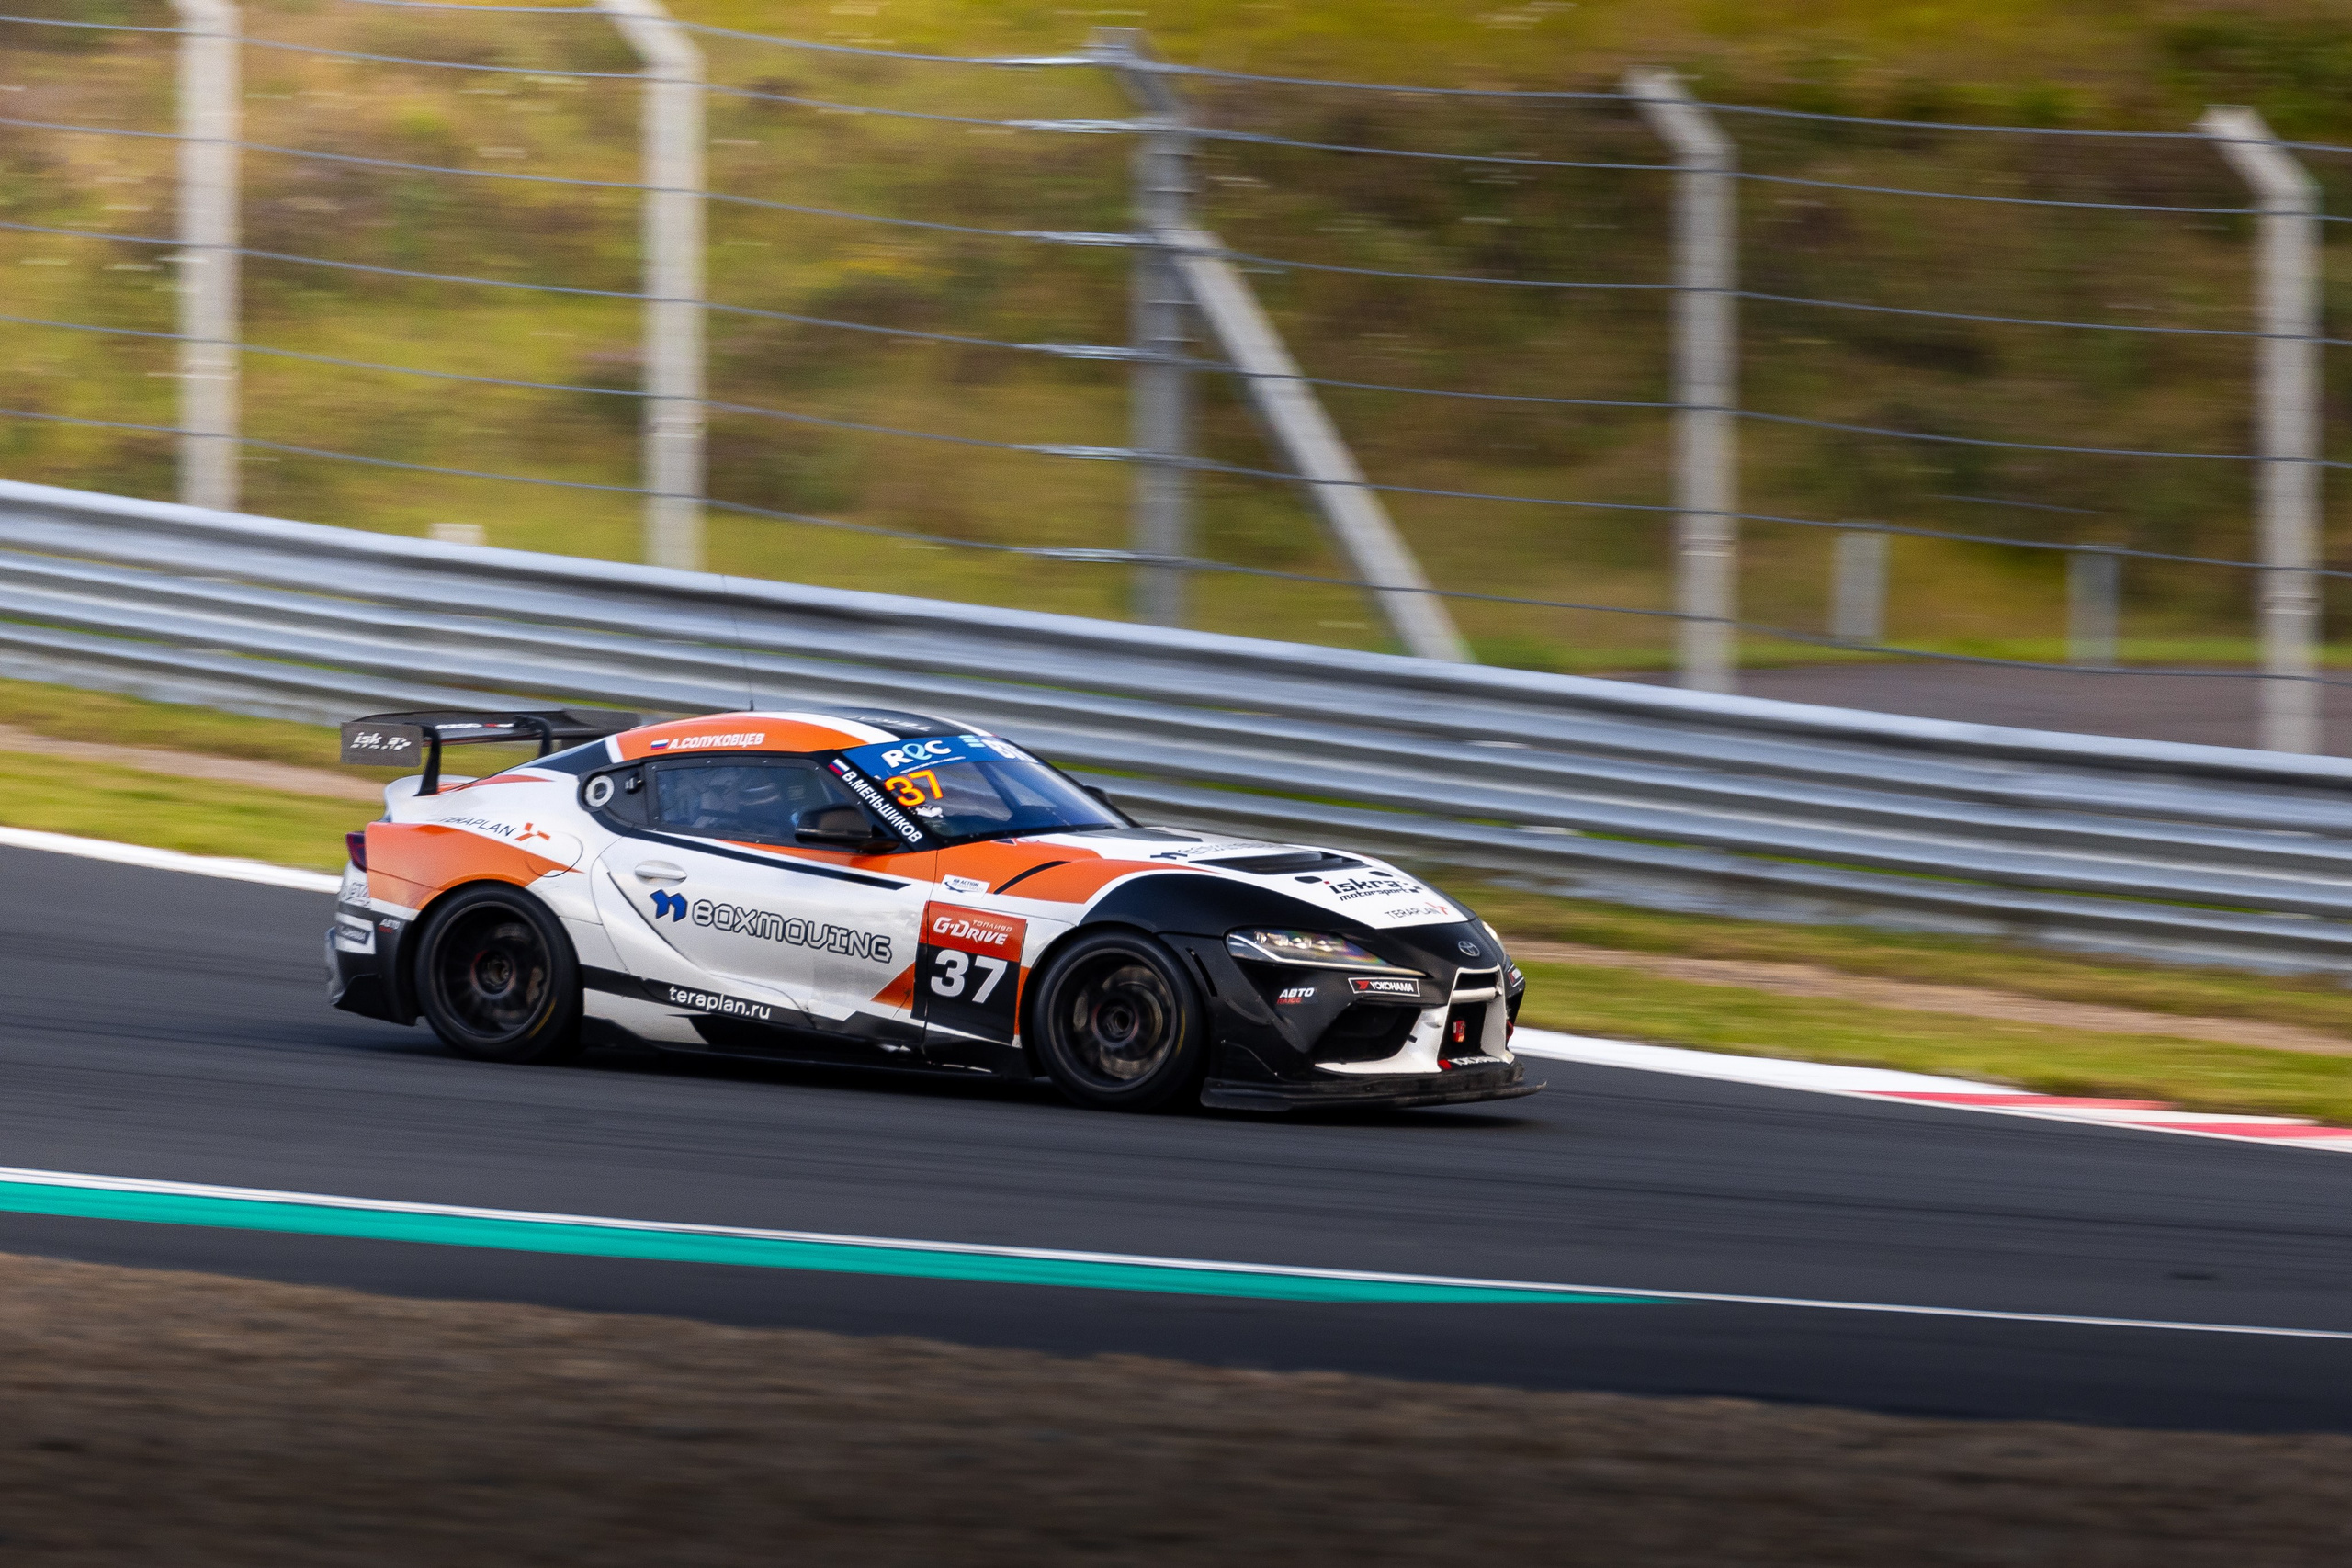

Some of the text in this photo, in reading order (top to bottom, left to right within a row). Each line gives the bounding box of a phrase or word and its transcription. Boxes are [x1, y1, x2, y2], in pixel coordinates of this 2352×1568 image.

[668, 733, 765, 749] А.СОЛУКОВЦЕВ
[884, 769, 944, 807] 37
[842, 771, 922, 843] В.МЕНЬШИКОВ
[440, 816, 516, 837] TERAPLAN
[1339, 887, 1409, 902] motorsport
[692, 899, 892, 964] BOXMOVING
[930, 949, 1008, 1004] 37
[1369, 981, 1415, 992] YOKOHAMA
[669, 986, 771, 1020] teraplan.ru
